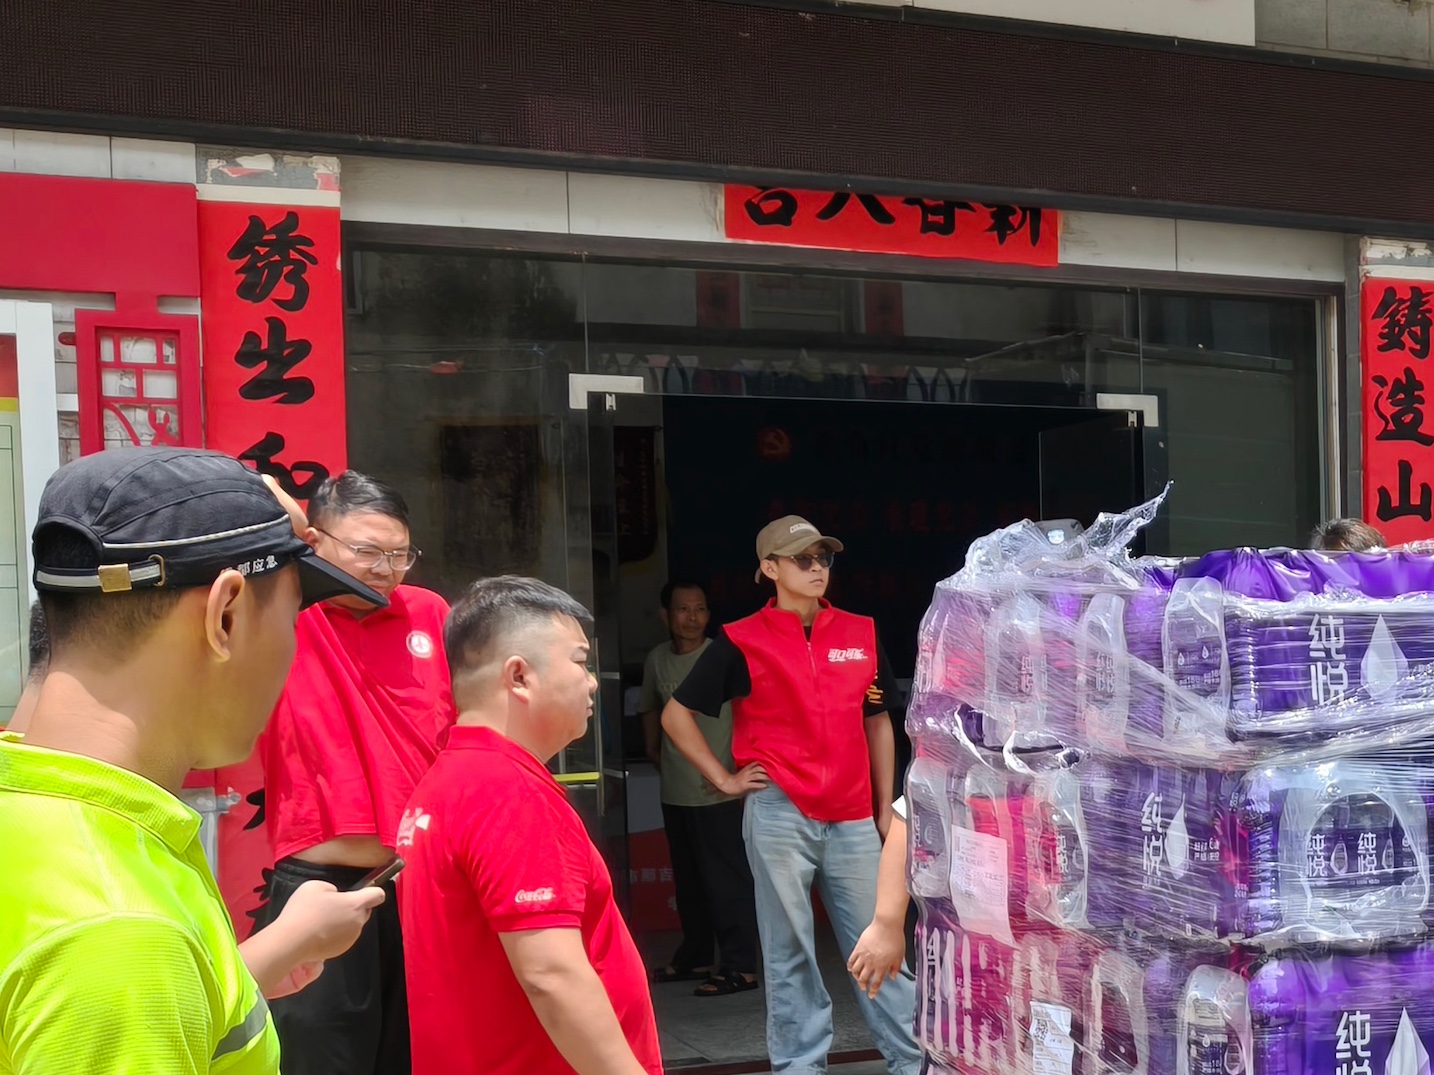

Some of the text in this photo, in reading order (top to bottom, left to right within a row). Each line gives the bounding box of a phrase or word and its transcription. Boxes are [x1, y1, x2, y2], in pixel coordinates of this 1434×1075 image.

[1309, 613, 1348, 704] 纯悦
[1307, 834, 1326, 878] 纯悦
[1357, 832, 1377, 875] 纯悦
